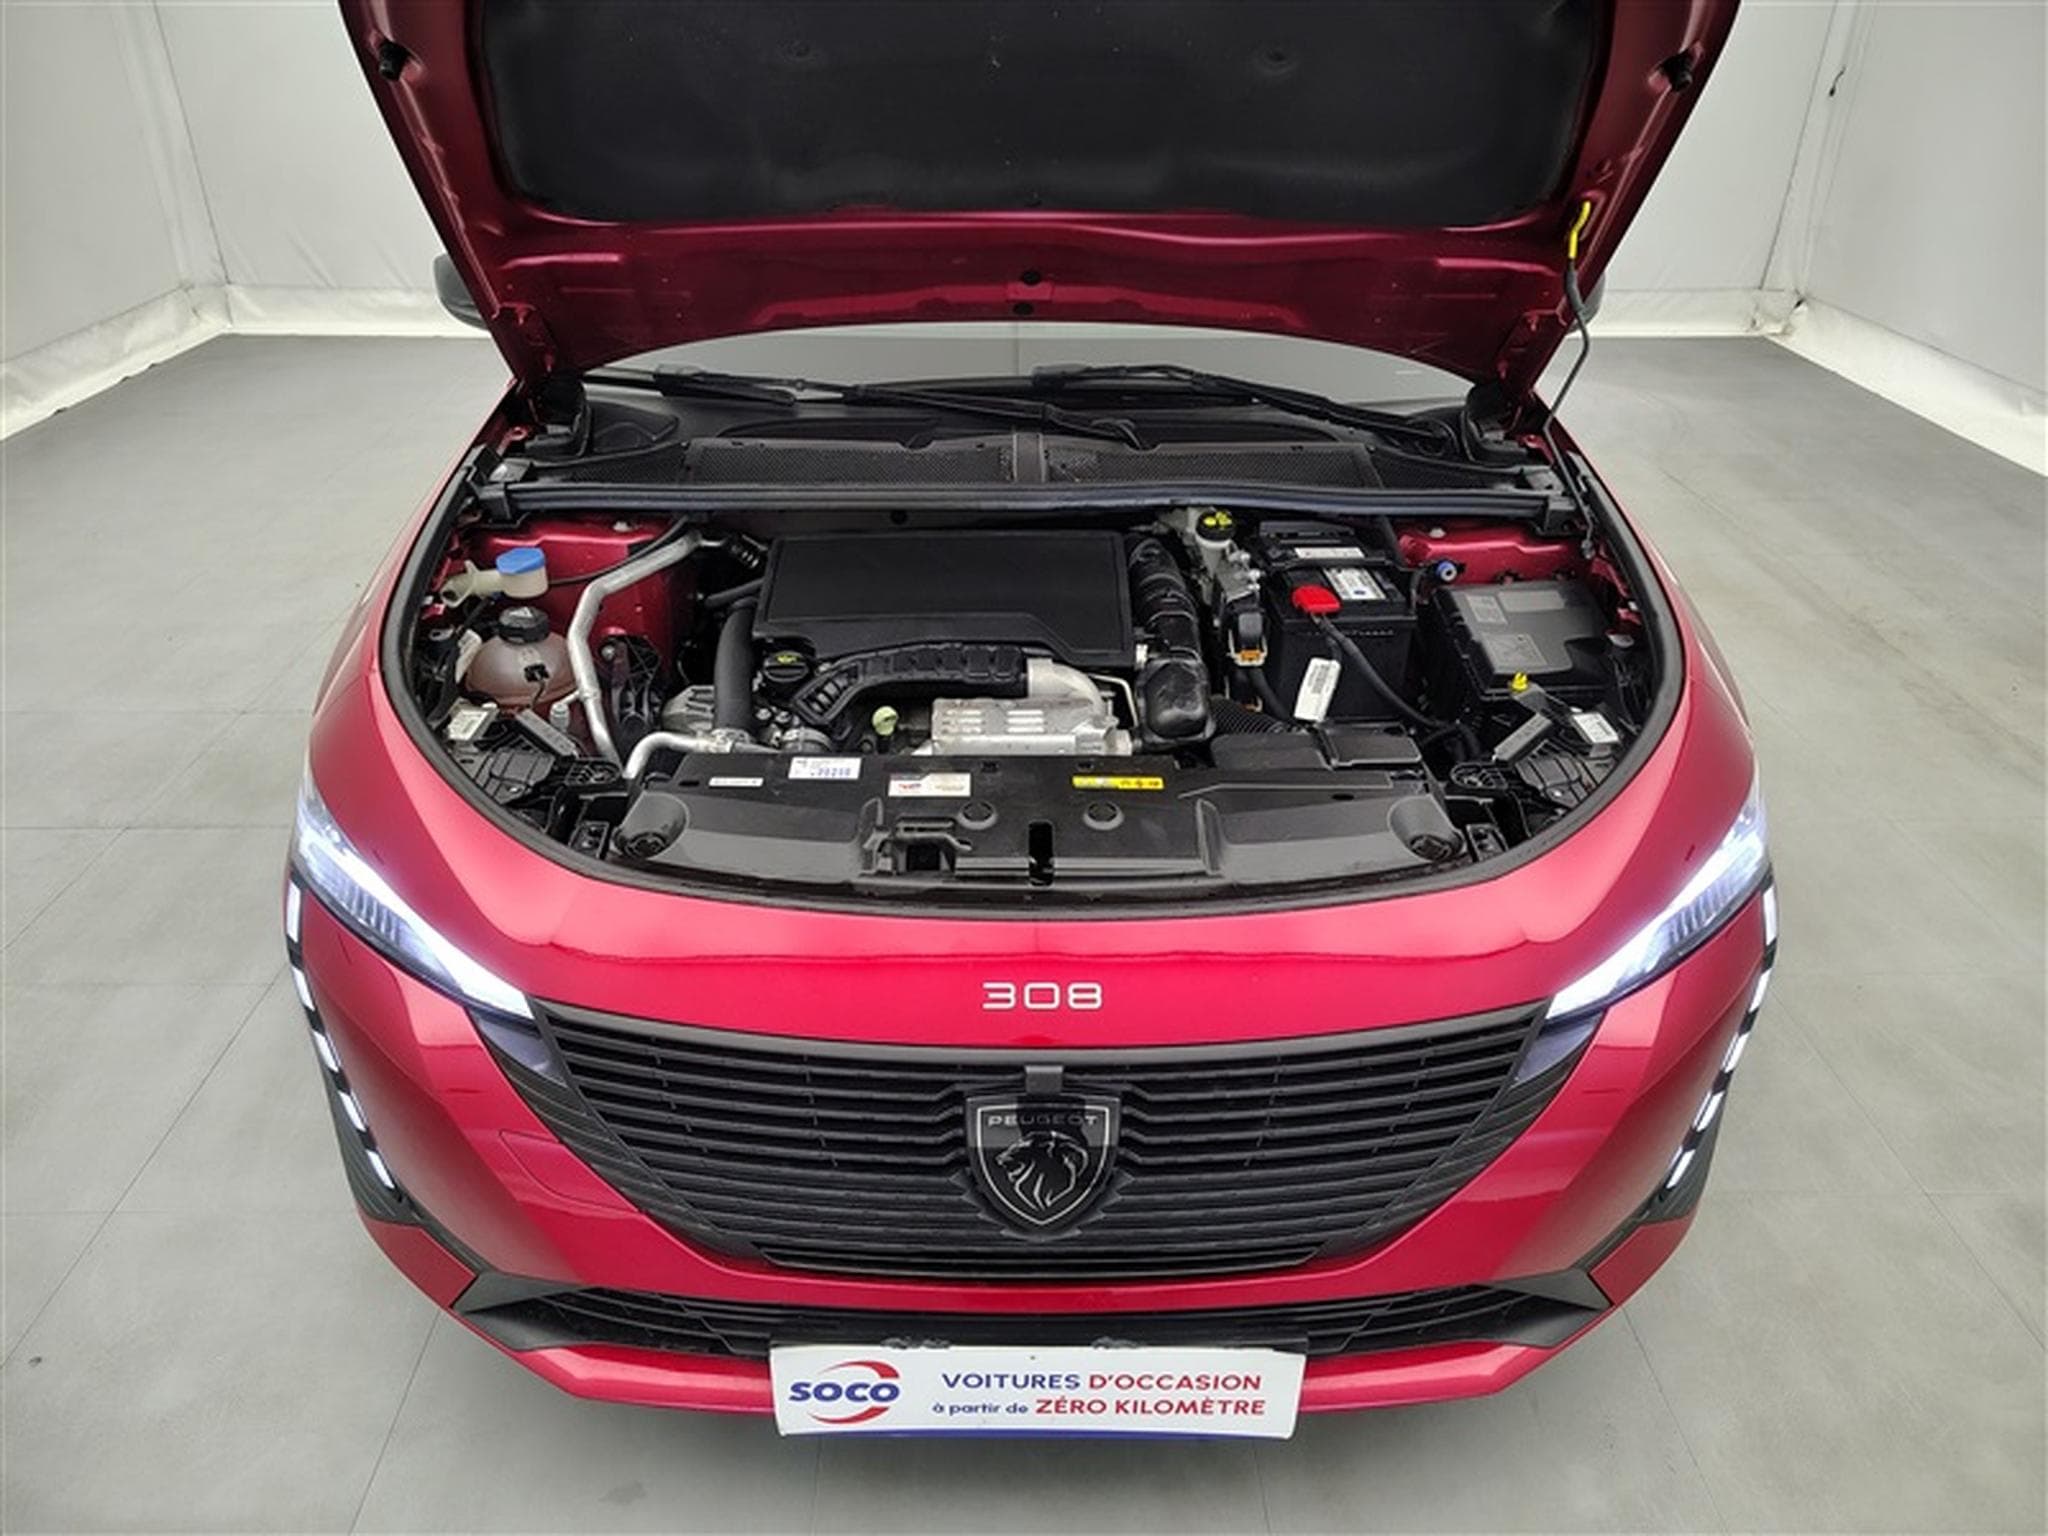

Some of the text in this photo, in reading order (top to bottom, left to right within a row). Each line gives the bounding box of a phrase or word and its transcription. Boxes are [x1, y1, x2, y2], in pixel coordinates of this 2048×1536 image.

[982, 982, 1102, 1009] 308
[987, 1114, 1098, 1127] PEUGEOT
[942, 1373, 1261, 1390] VOITURES D'OCCASION
[788, 1382, 900, 1402] SOCO
[932, 1396, 1266, 1416] à partir de ZÉRO KILOMÈTRE
